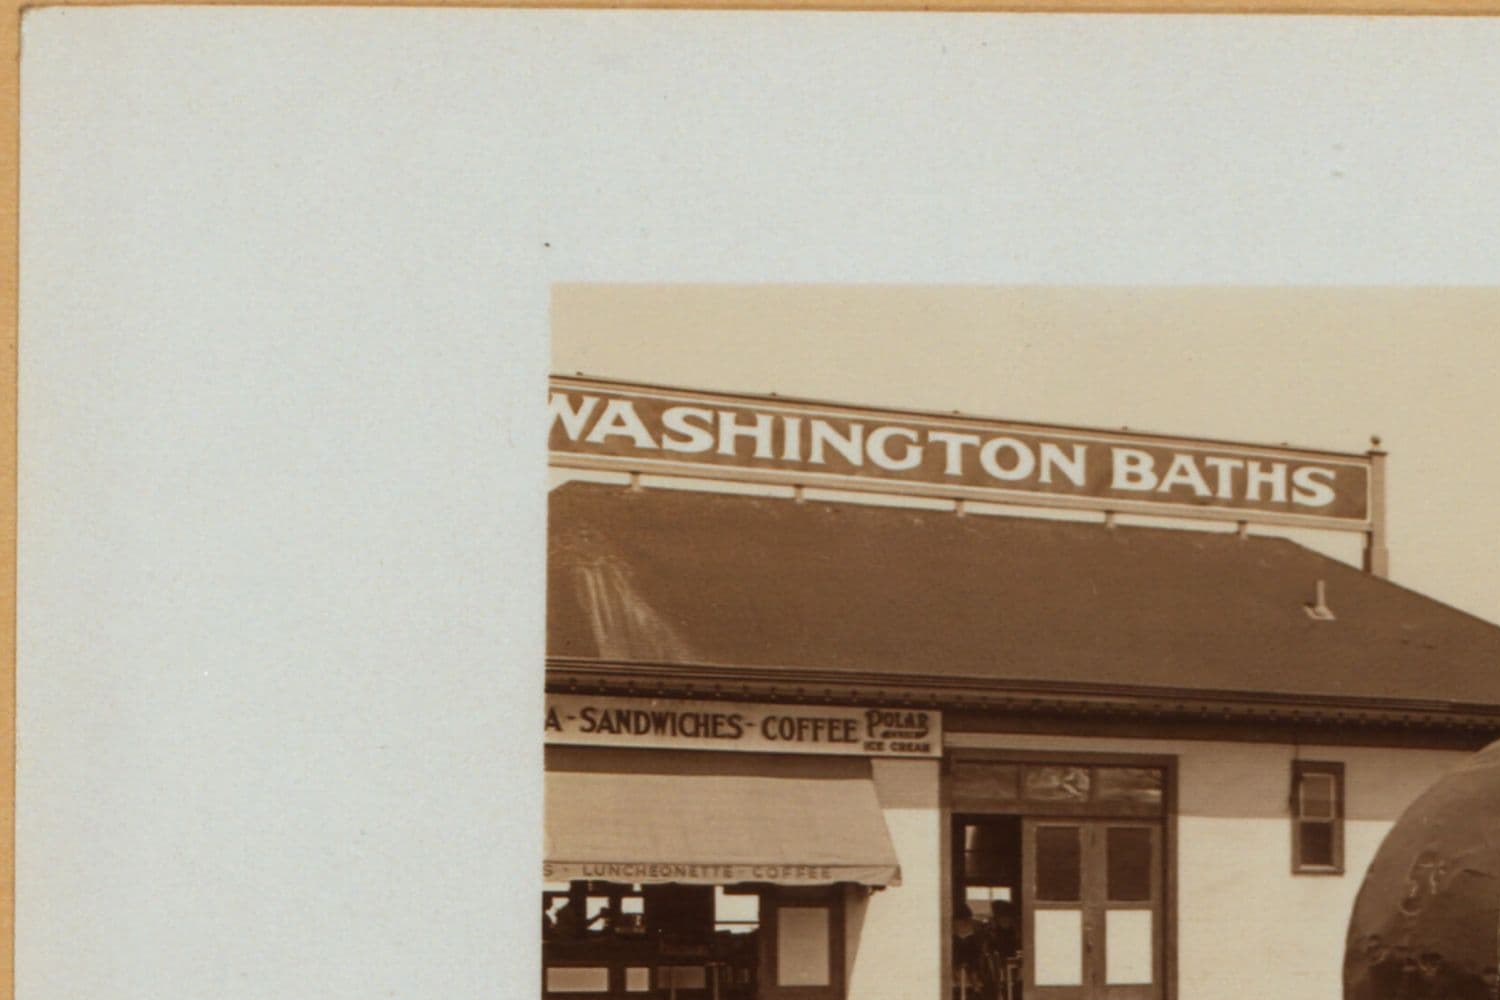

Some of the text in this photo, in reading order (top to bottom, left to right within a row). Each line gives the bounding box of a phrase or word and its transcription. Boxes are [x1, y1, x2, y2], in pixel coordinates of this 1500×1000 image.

[547, 393, 1336, 507] WASHINGTON BATHS
[579, 706, 743, 740] SANDWICHES
[761, 715, 859, 743] COFFEE
[865, 710, 929, 738] POLAR
[864, 741, 884, 752] ICE
[582, 864, 734, 879] LUNCHEONETTE
[752, 865, 832, 880] COFFEE
